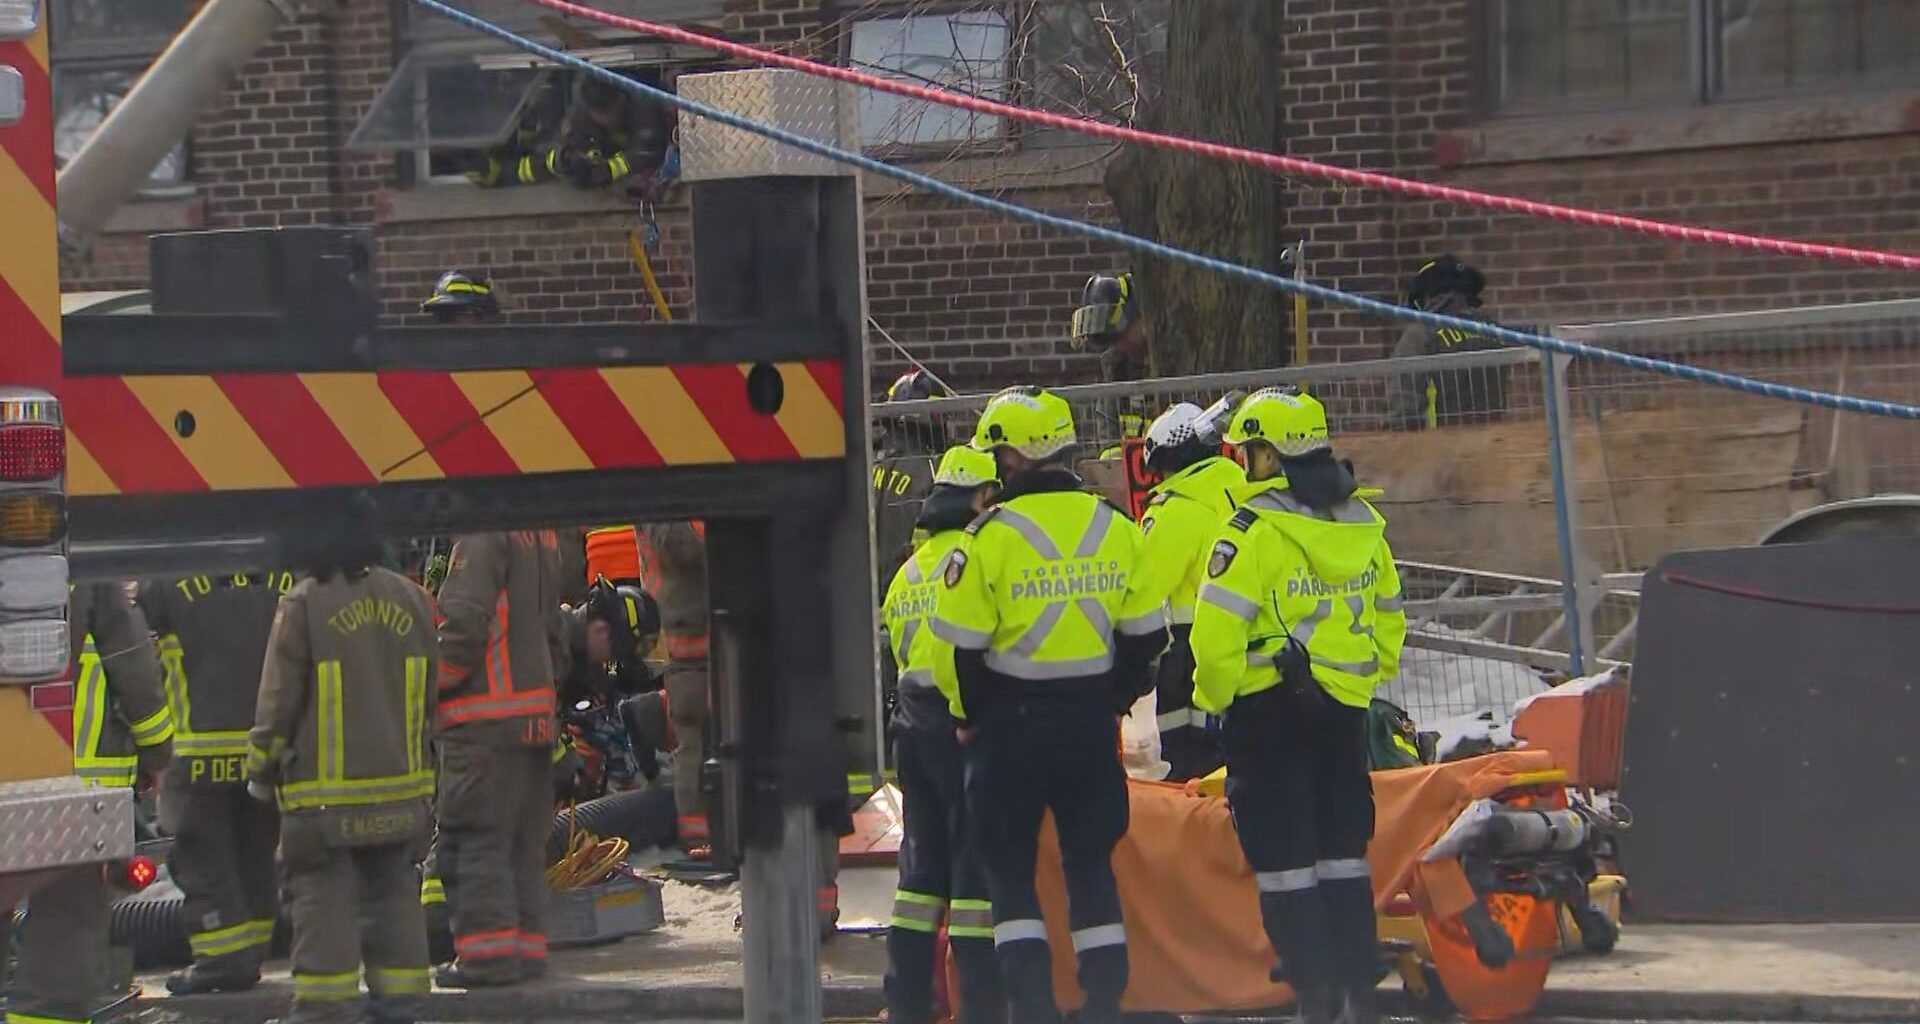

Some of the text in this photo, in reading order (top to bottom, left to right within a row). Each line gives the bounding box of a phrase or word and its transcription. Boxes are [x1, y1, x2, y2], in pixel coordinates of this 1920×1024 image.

[1022, 560, 1118, 579] TORONTO
[1011, 571, 1126, 601] PARAMEDIC
[328, 598, 413, 637] TORONTO
[191, 758, 205, 784] P
